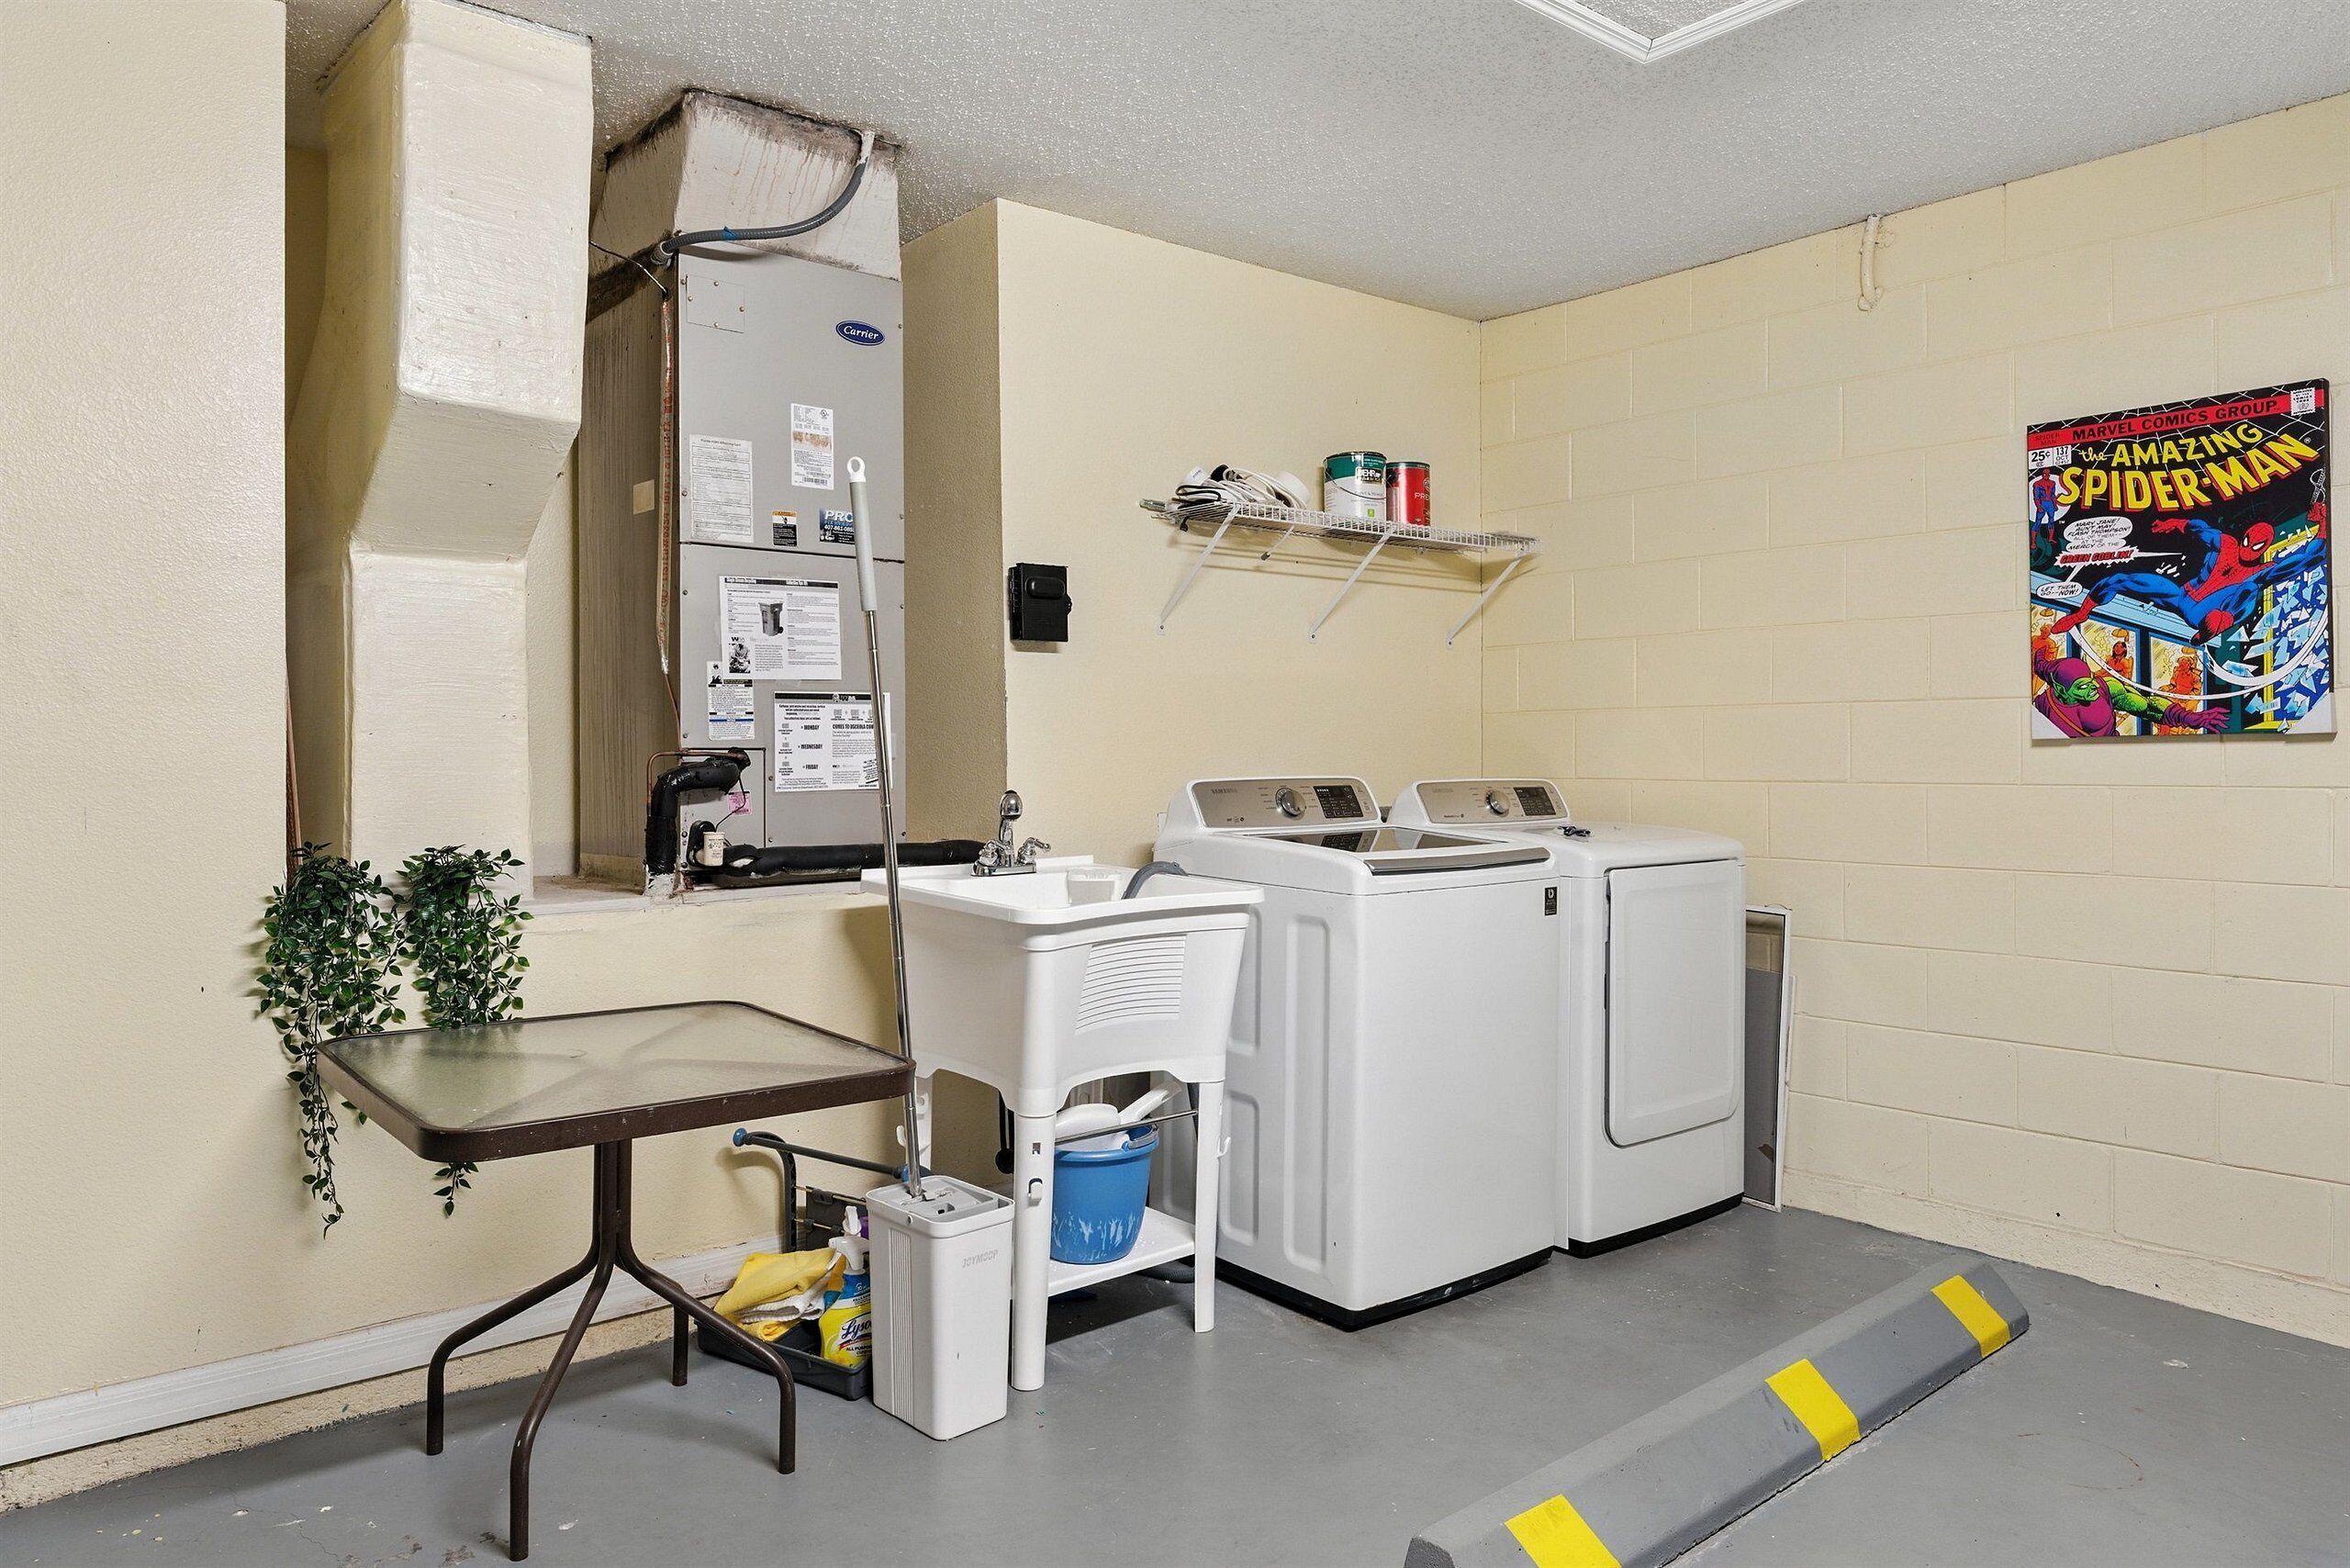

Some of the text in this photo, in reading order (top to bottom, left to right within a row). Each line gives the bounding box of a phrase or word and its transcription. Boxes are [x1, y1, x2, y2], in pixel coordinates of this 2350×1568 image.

[844, 325, 878, 339] Carrier
[2073, 399, 2278, 441] MARVEL COMICS GROUP
[2056, 446, 2069, 456] 137
[2079, 423, 2263, 467] the AMAZING
[2057, 433, 2321, 511] SPIDER-MAN
[2091, 526, 2131, 535] THOMPSON!
[2060, 549, 2134, 564] GREEN GOBLIN!
[842, 1319, 871, 1339] Lyso
